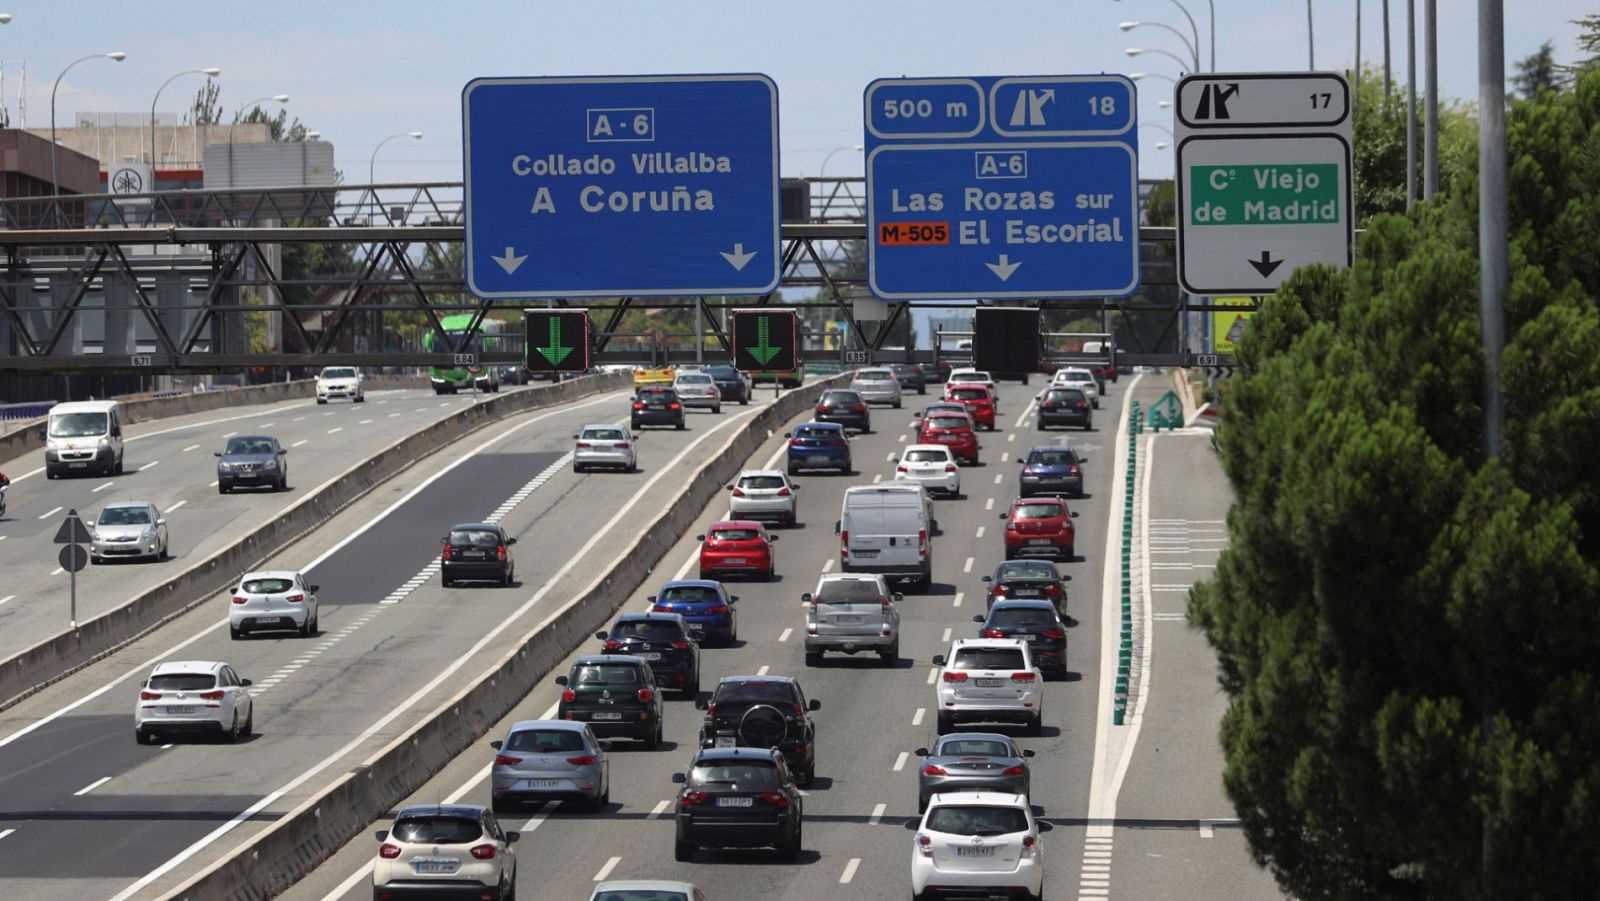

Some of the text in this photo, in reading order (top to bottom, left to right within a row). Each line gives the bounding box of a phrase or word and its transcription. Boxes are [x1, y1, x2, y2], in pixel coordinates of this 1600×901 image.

[884, 99, 968, 118] 500 m
[1088, 96, 1115, 116] 18
[1309, 93, 1332, 109] 17
[512, 151, 732, 176] Collado Villalba
[980, 155, 1022, 176] A-6
[1253, 168, 1320, 193] Viejo
[531, 185, 715, 214] A Coruña
[892, 187, 1114, 213] Las Rozas sur
[1194, 199, 1336, 222] de Madrid
[881, 227, 945, 244] M-505
[959, 217, 1124, 245] El Escorial
